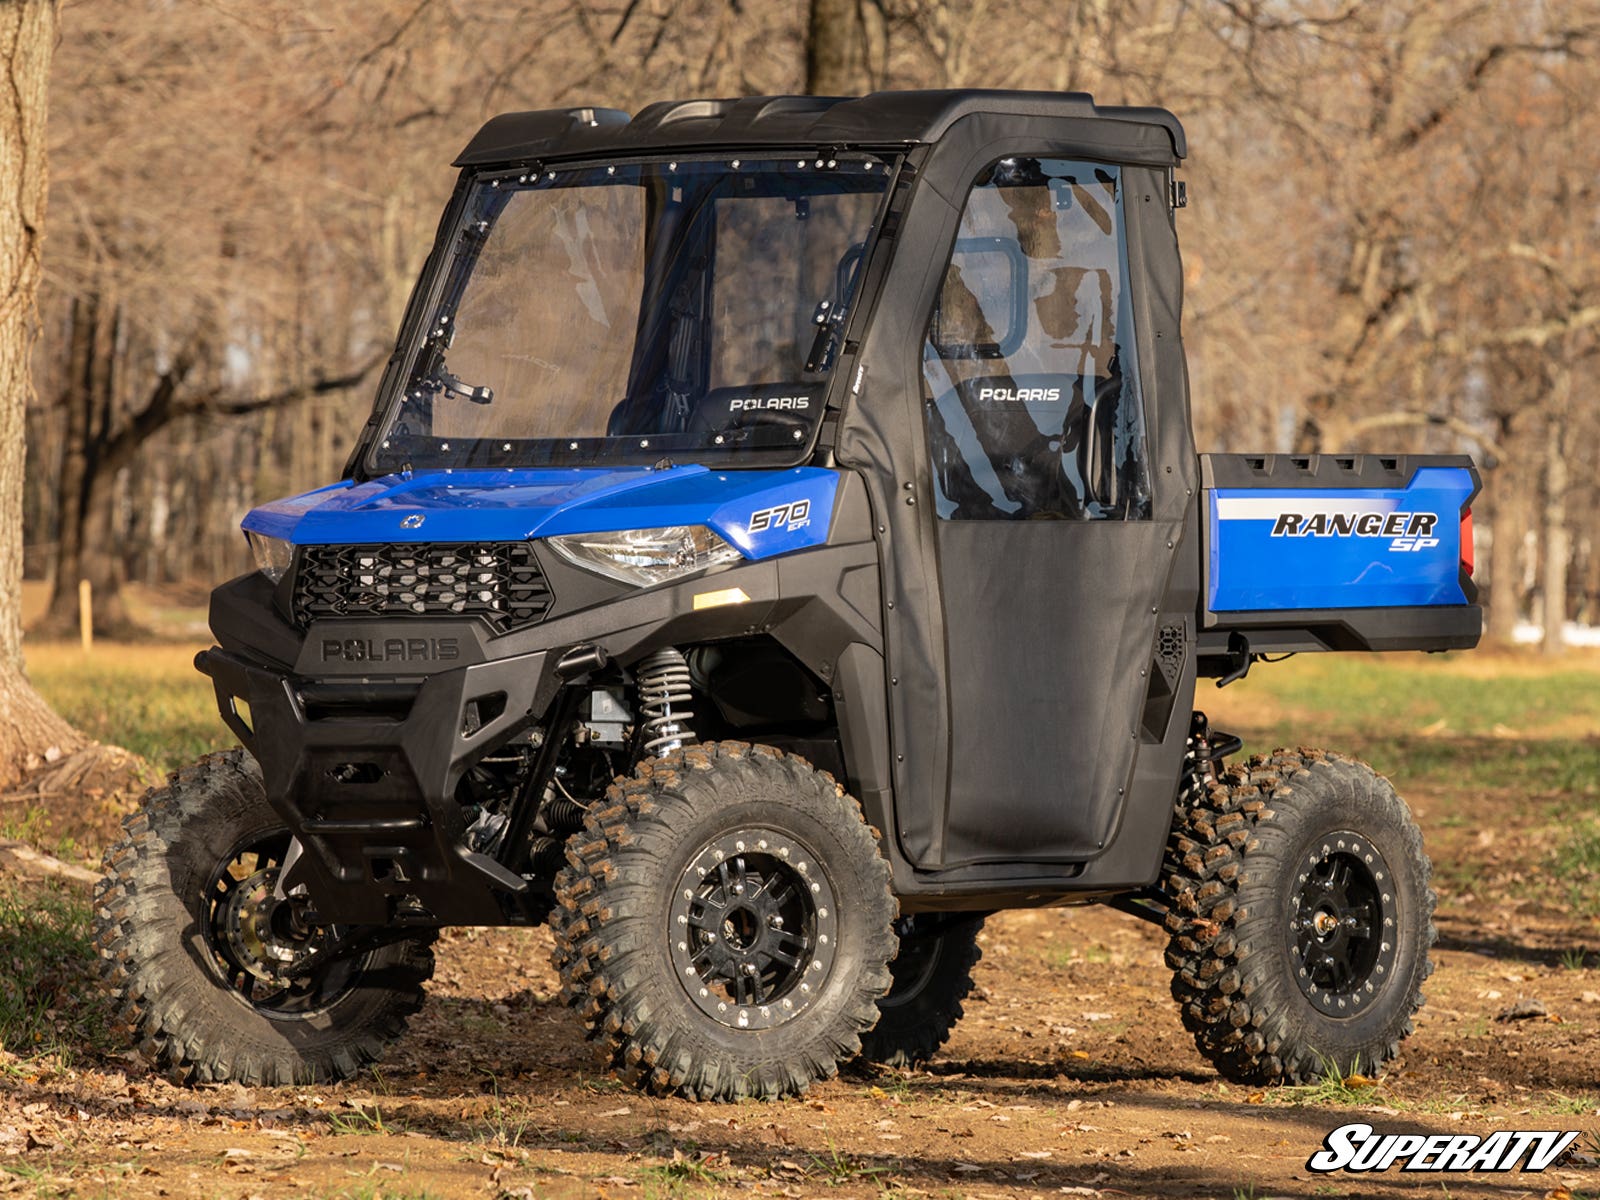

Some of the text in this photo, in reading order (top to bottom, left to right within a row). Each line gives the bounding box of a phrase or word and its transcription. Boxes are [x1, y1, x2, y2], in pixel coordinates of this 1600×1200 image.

[729, 397, 809, 411] POLARIS
[980, 388, 1060, 401] POLARIS
[749, 499, 811, 533] 570
[1271, 512, 1439, 537] RANGER
[1388, 538, 1440, 552] SP
[321, 638, 459, 662] POLARIS
